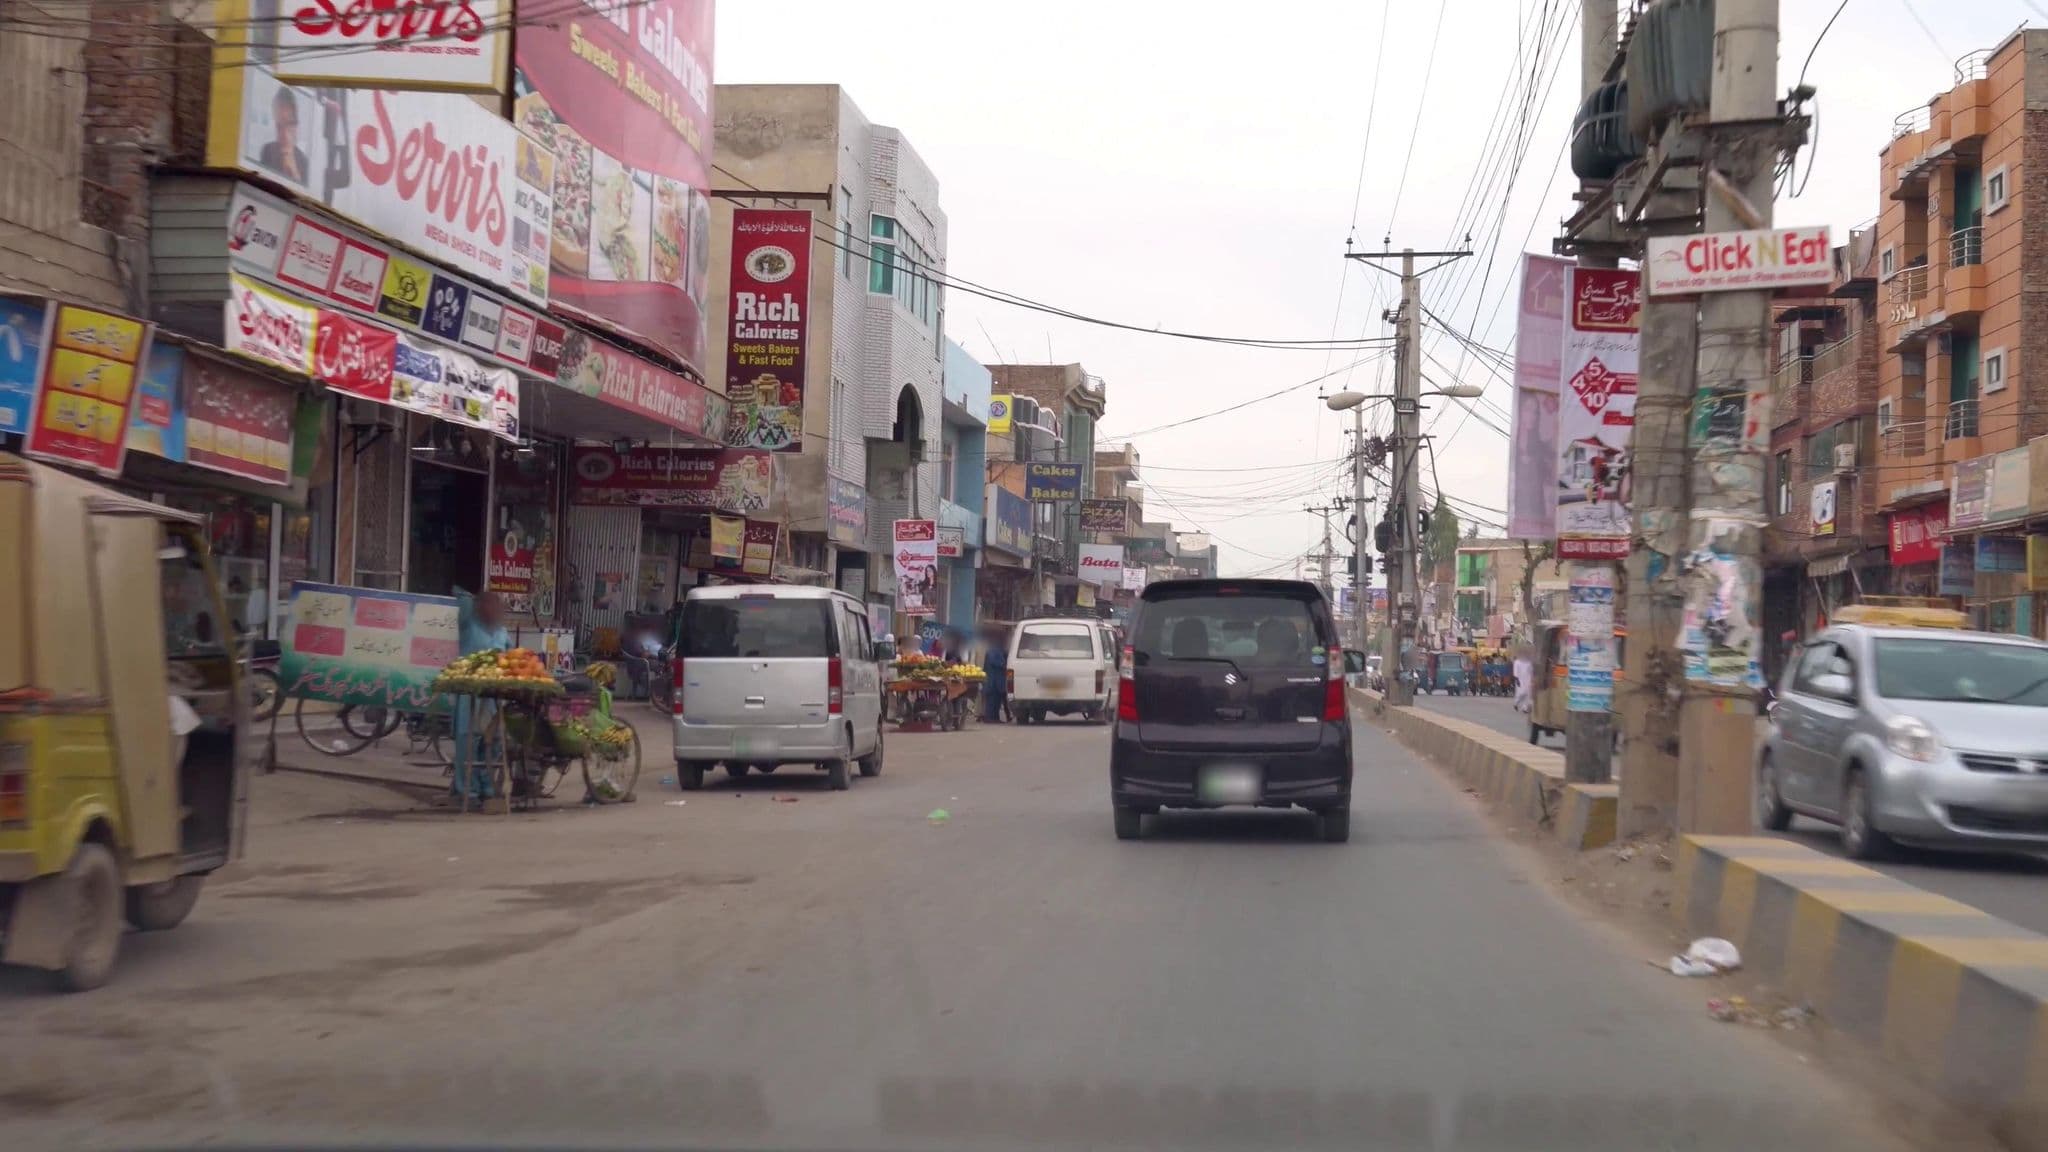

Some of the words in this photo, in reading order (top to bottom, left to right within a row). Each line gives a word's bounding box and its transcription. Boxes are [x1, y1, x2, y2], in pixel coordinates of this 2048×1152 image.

[356, 87, 508, 247] Servis
[478, 246, 504, 271] STORE
[1685, 235, 1753, 274] Click
[1756, 235, 1779, 266] N
[1784, 231, 1829, 266] Eat
[735, 291, 800, 322] Rich
[735, 322, 799, 340] Calories
[733, 342, 766, 354] Sweets
[768, 343, 800, 355] Bakers
[739, 355, 746, 365] &
[749, 355, 769, 366] Fast
[771, 355, 793, 366] Food
[1590, 362, 1601, 376] 5
[602, 354, 635, 402] Rich
[638, 369, 688, 422] Calories
[1573, 375, 1585, 389] 4
[1604, 377, 1616, 392] 7
[1586, 392, 1605, 407] 10
[1032, 464, 1076, 476] Cakes
[1080, 556, 1120, 569] Bata
